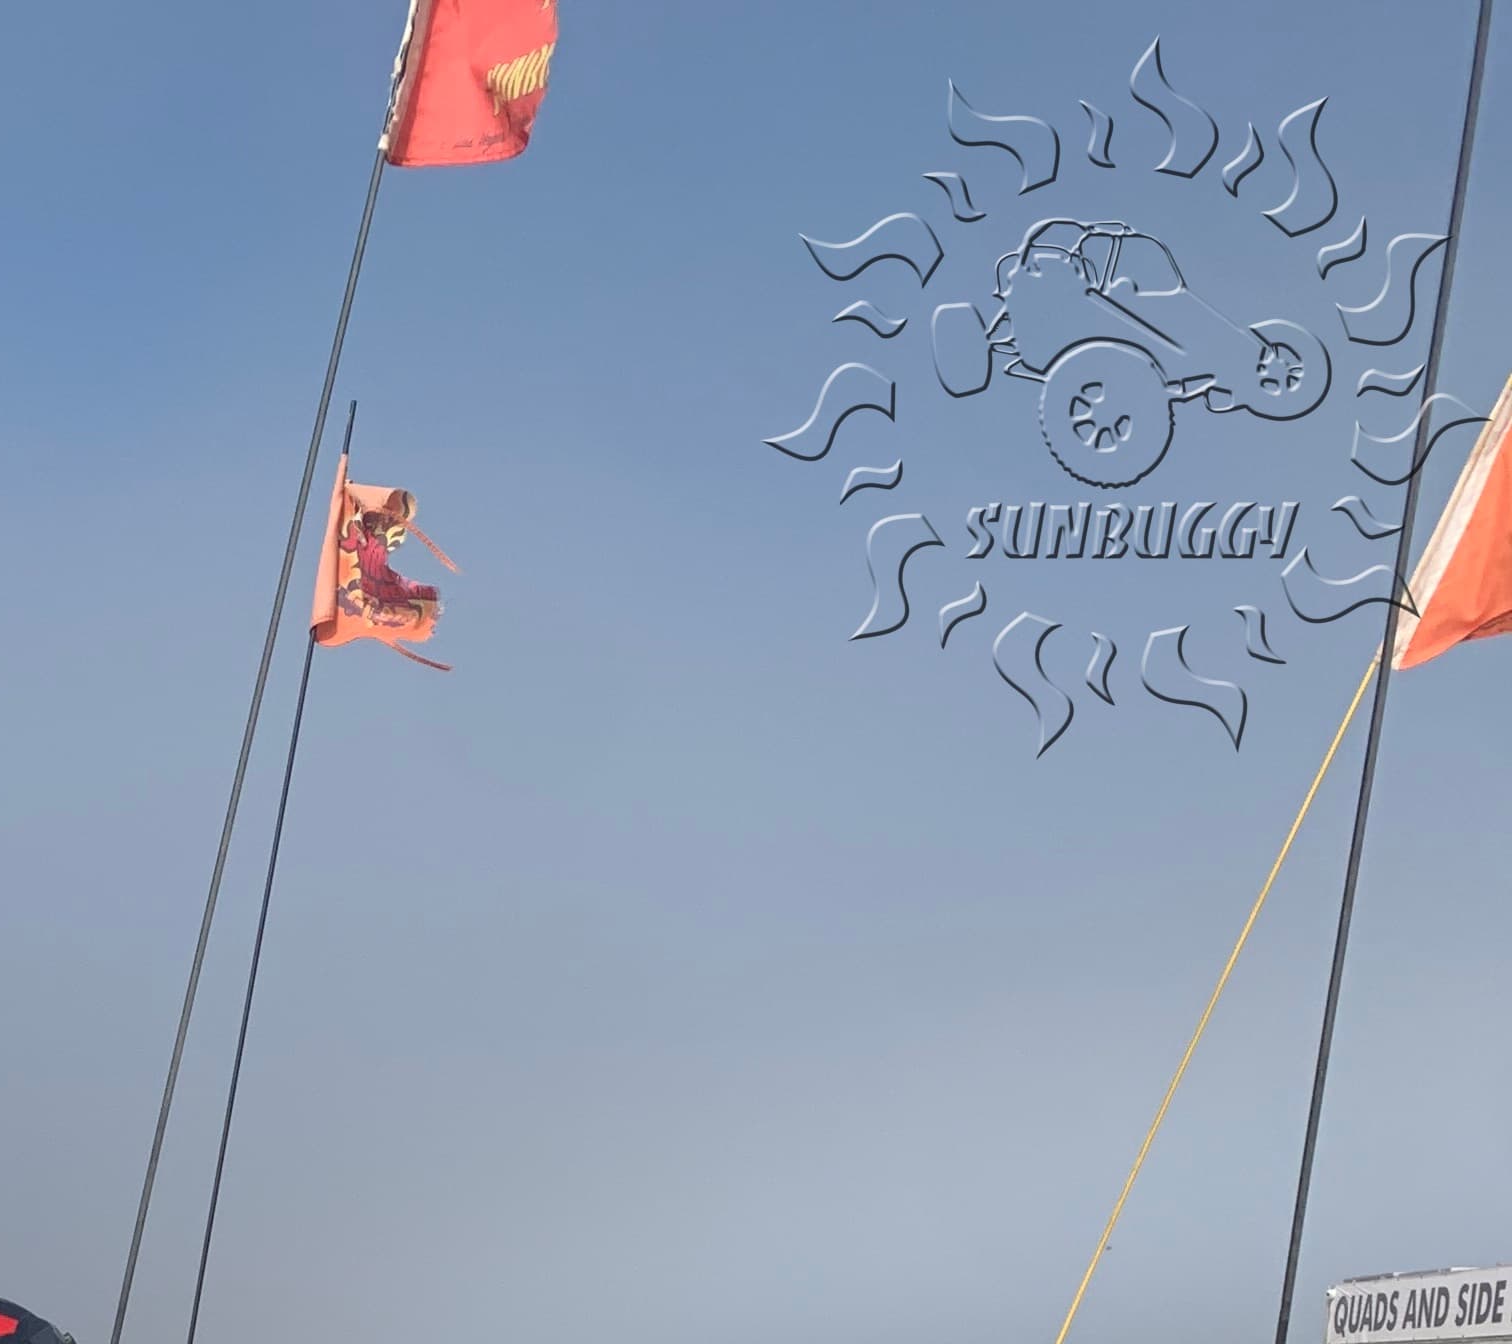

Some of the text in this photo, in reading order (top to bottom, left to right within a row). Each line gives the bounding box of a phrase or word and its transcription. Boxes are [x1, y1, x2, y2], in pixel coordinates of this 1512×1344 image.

[1334, 1280, 1507, 1337] QUADS AND SIDE
